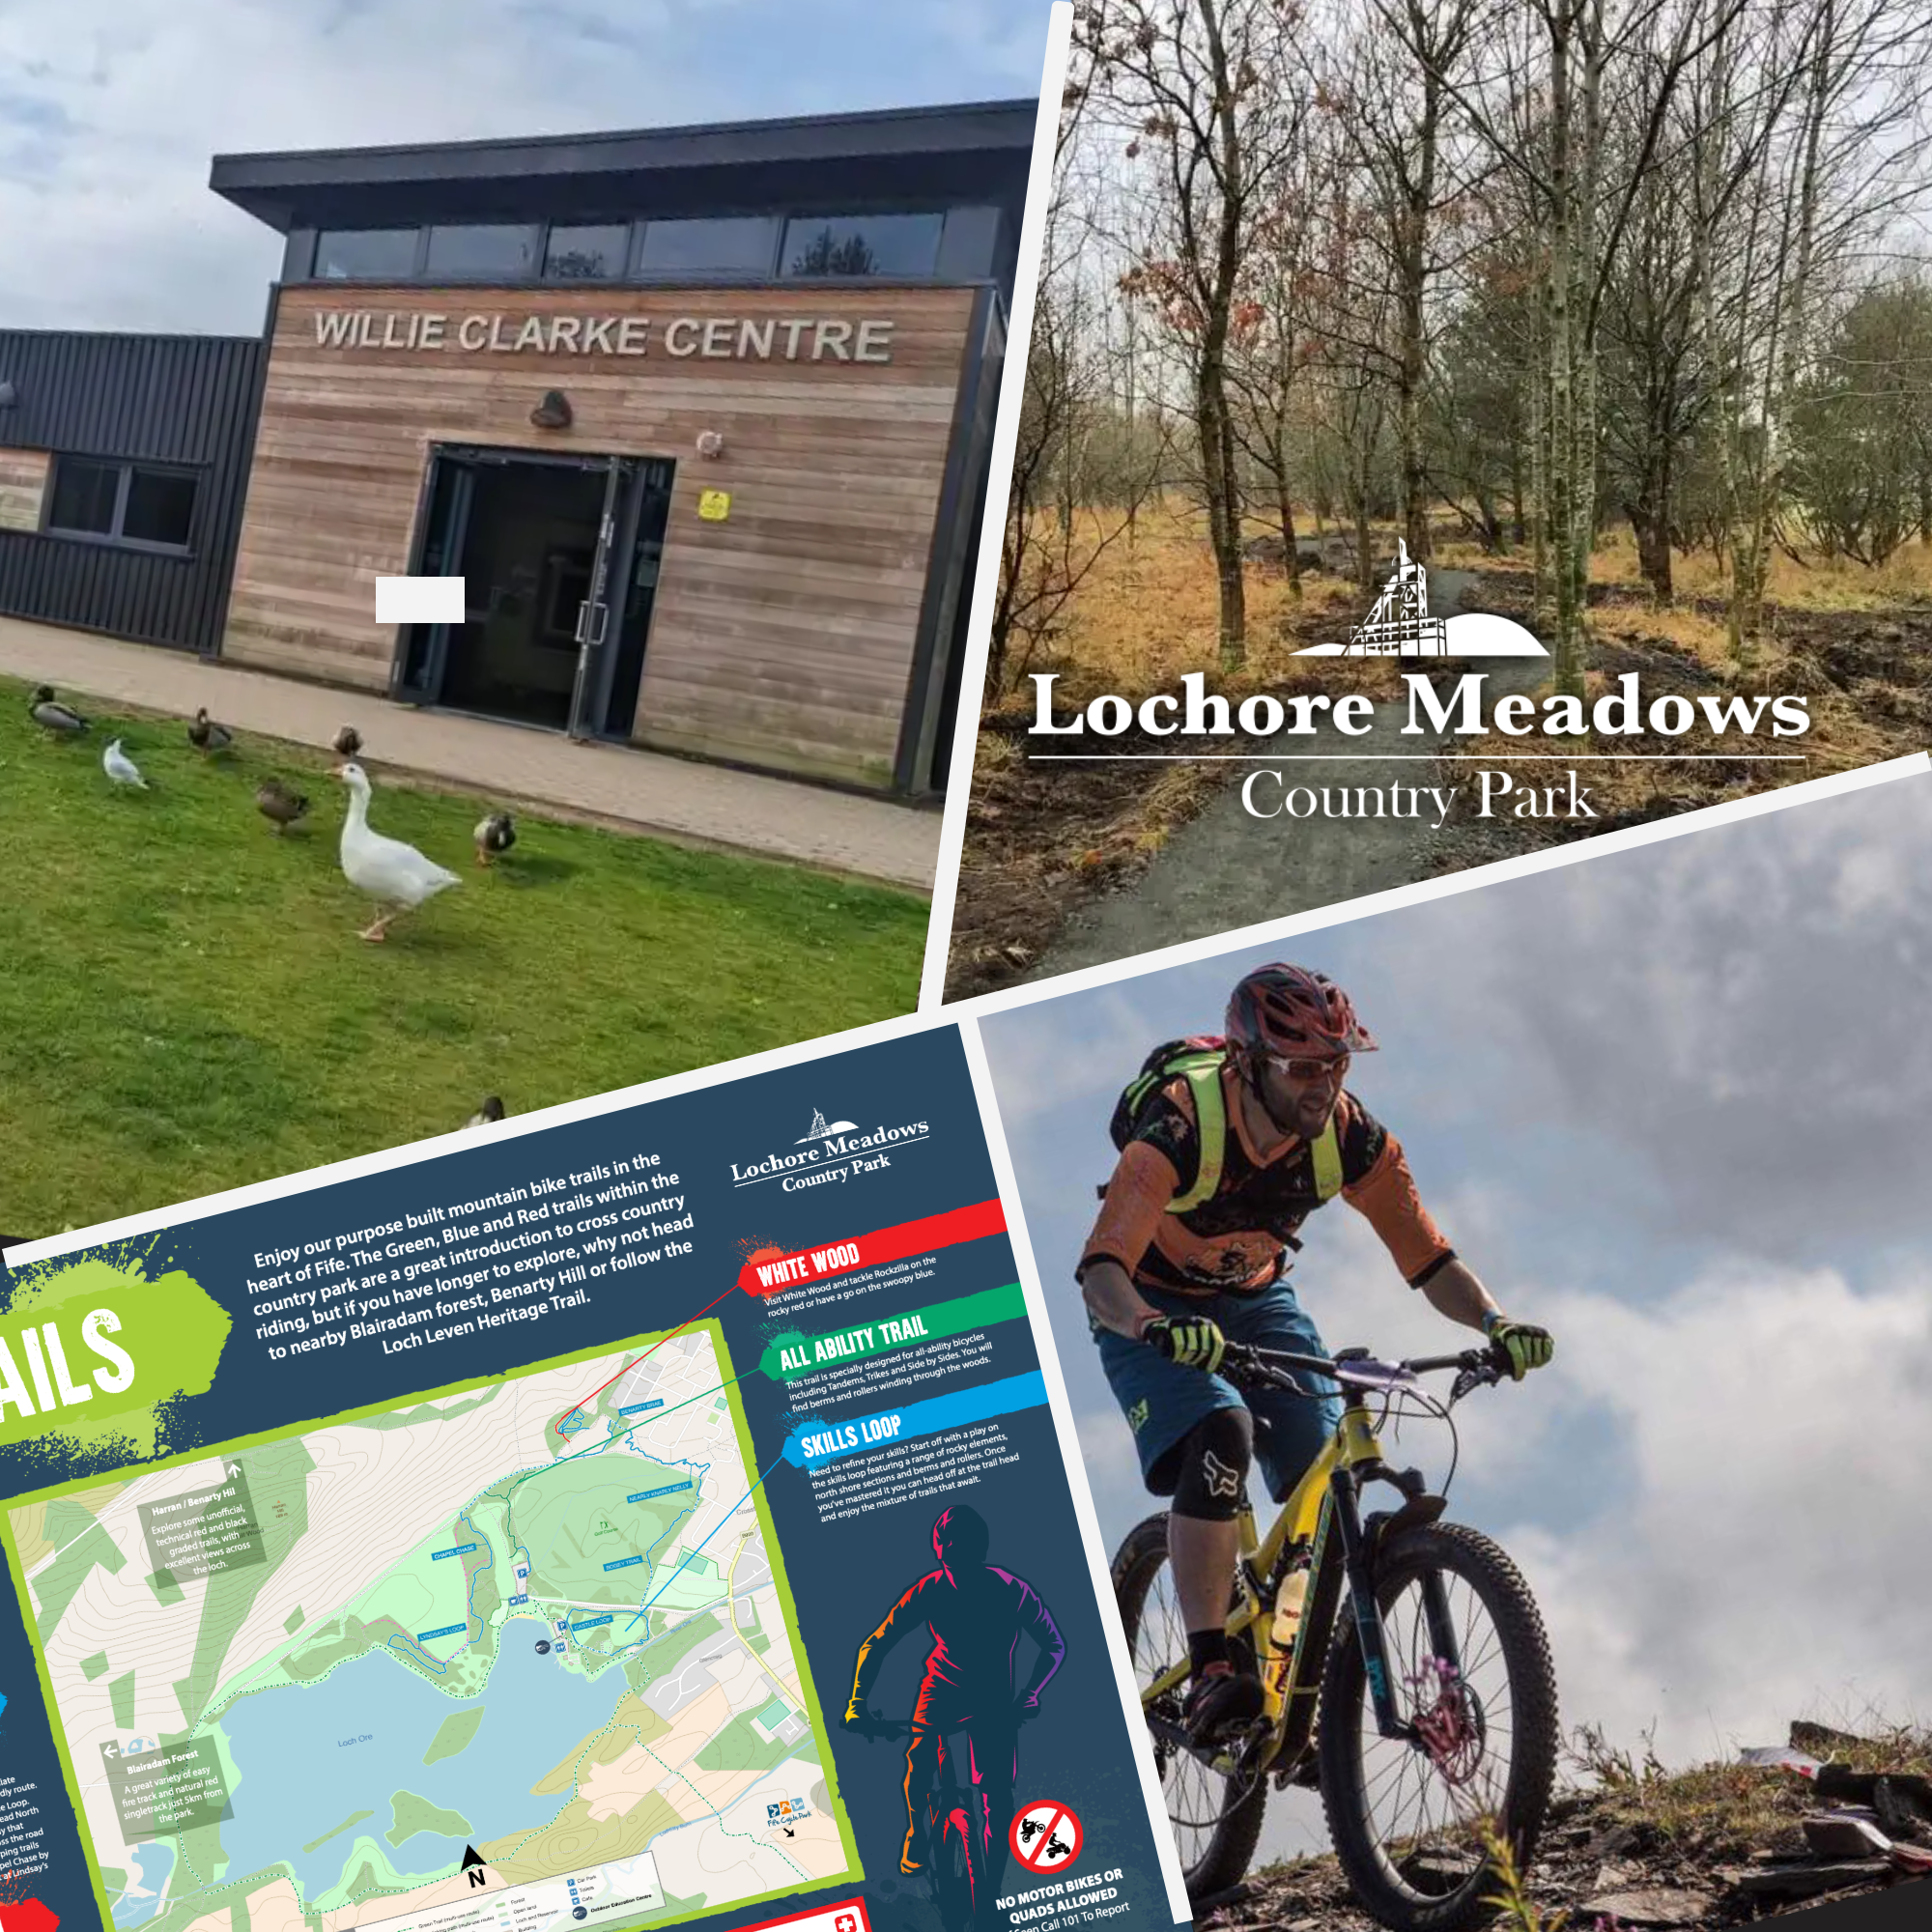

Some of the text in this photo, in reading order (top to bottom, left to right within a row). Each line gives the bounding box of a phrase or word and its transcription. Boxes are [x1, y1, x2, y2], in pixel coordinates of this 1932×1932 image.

[314, 311, 895, 363] WILLIE CLARKE CENTRE
[729, 1121, 929, 1181] Lochore Meadows
[781, 1153, 892, 1192] Country Park
[253, 1153, 661, 1268] Enjoy our purpose built mountain bike trails in the
[246, 1173, 680, 1294] heart of Fife. The Green, Blue and Red trails within the
[253, 1195, 685, 1317] country park are a great introduction to cross country
[755, 1242, 860, 1288] WHITE WOOD
[255, 1212, 695, 1340] riding, but if you have longer to explore, why not head
[763, 1257, 937, 1307] Visit White Wood and tackle Rockzilla on the
[767, 1306, 790, 1318] rocky
[790, 1300, 805, 1312] red
[814, 1294, 836, 1306] have
[842, 1290, 855, 1300] go
[855, 1287, 867, 1295] on
[867, 1283, 882, 1292] the
[882, 1274, 914, 1289] swoopy
[914, 1269, 936, 1280] blue.
[268, 1241, 693, 1360] to nearby Blairadam forest, Benarty Hill or follow the
[382, 1289, 591, 1354] Loch Leven Heritage Trail.
[781, 1315, 928, 1372] ALL ABILITY TRAIL
[785, 1333, 985, 1390] This trail is specially designed for all-ability bicycles
[801, 1414, 901, 1459] SKILLS LOOP
[151, 1504, 245, 1535] Explore some unofficial,
[152, 1503, 183, 1517] Harran
[187, 1492, 221, 1507] Benarty
[156, 1517, 247, 1547] technical red and black
[169, 1531, 240, 1558] graded trails, with
[164, 1542, 250, 1569] excellent views across
[193, 1560, 229, 1575] the loch.
[337, 1734, 373, 1747] Loch Ore
[125, 1766, 211, 1795] A great variety of easy
[127, 1749, 199, 1775] Blairadam Forest
[6, 1799, 30, 1810] Loop.
[122, 1776, 218, 1807] fire track and natural red
[14, 1805, 40, 1819] North
[12, 1861, 48, 1878] Lindsay's
[13, 1851, 49, 1866] Chase by
[468, 1868, 487, 1889] N
[995, 1868, 1123, 1911] NO MOTOR BIKES OR
[1009, 1887, 1118, 1924] QUADS ALLOWED
[1040, 1918, 1061, 1932] Call
[1062, 1914, 1079, 1927] 101
[1080, 1911, 1094, 1921] To
[1094, 1901, 1130, 1918] Report
